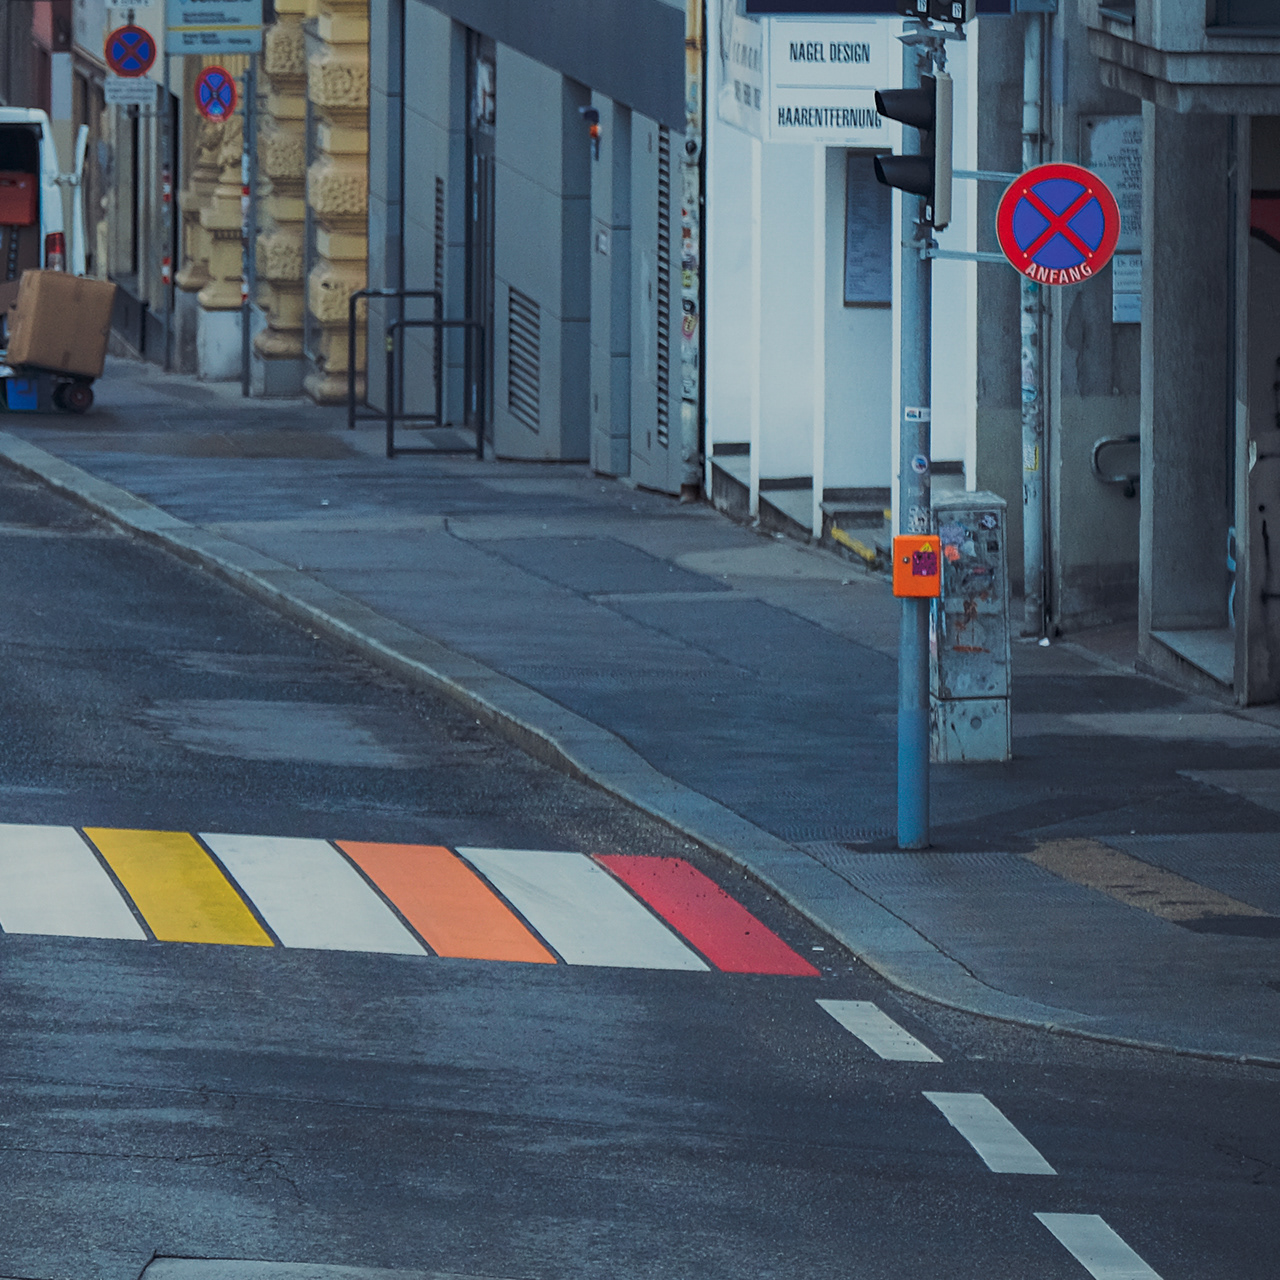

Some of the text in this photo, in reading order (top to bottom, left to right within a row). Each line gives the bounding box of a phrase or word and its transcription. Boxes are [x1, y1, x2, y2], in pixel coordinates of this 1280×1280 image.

[790, 41, 870, 64] NAGEL DESIGN
[778, 107, 882, 129] HAARENTFERNUNG
[1025, 262, 1093, 284] ANFANG
